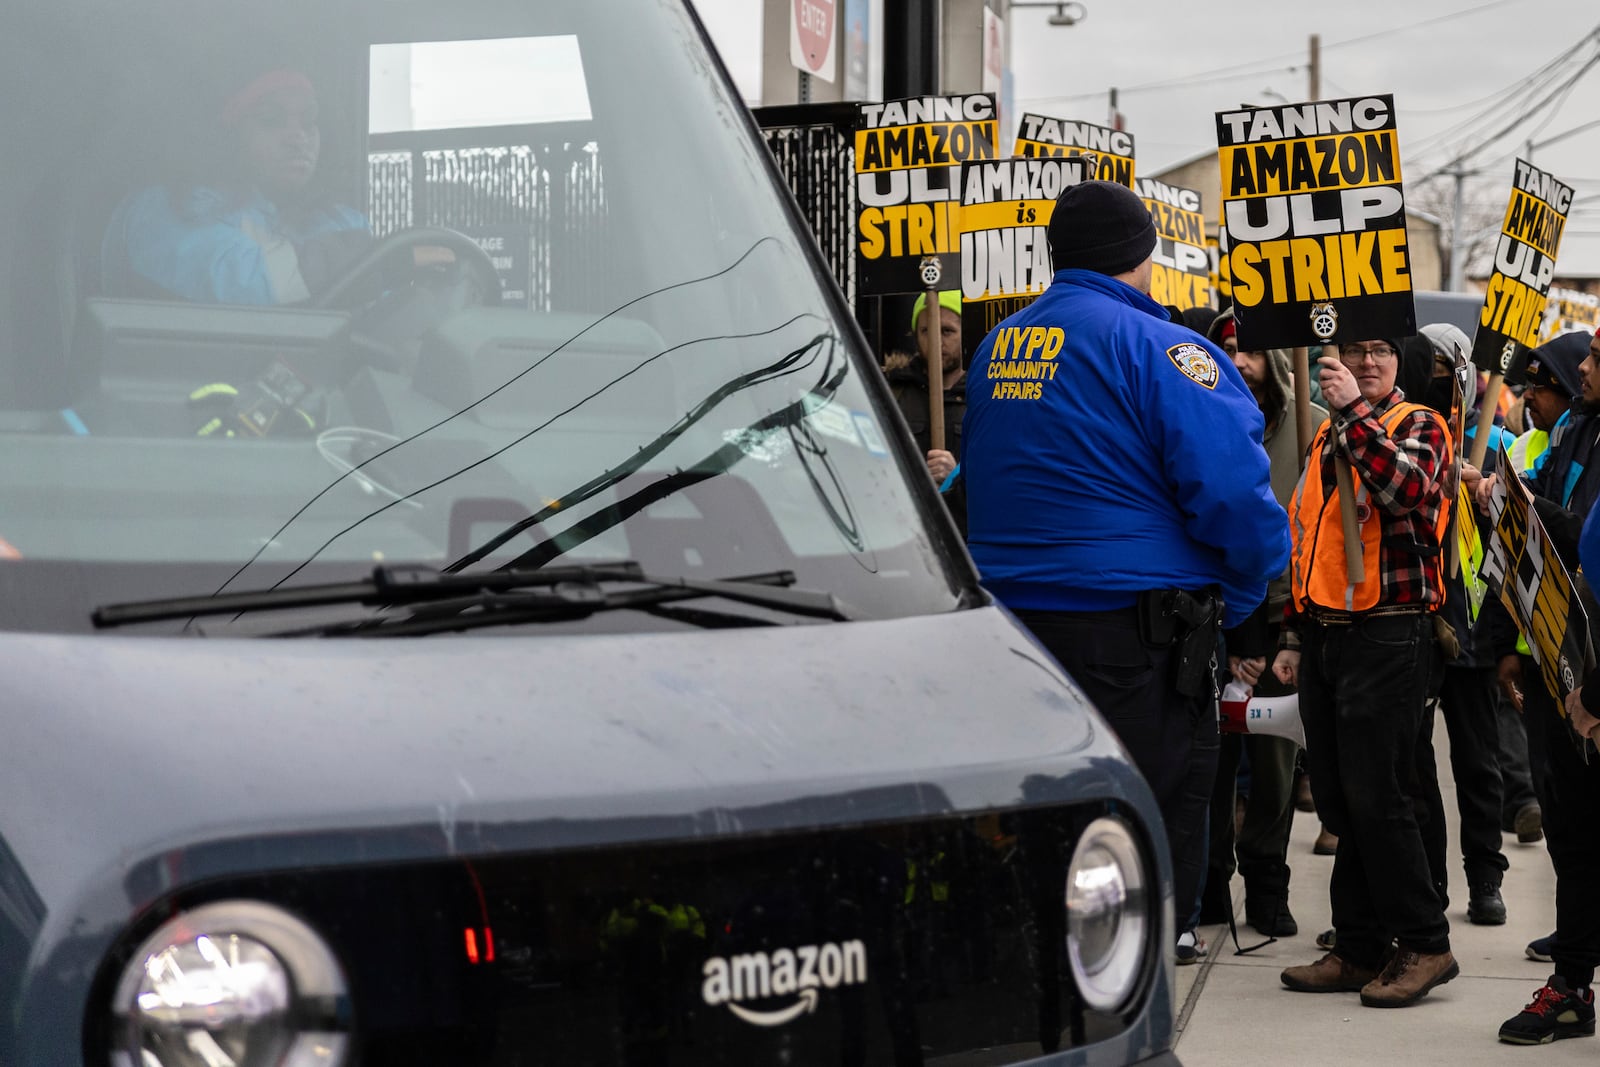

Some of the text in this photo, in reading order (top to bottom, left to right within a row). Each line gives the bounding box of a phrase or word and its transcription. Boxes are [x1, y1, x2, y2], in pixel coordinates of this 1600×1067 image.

[861, 94, 993, 129] TANNC
[1222, 97, 1388, 143] TANNC
[862, 122, 994, 170] AMAZON
[1024, 115, 1132, 156] TANNC
[963, 161, 1082, 206] AMAZON
[1230, 132, 1395, 196] AMAZON
[1016, 202, 1036, 224] is
[1135, 178, 1200, 212] NNC
[1225, 186, 1404, 242] ULP
[859, 201, 960, 260] STRI
[1150, 202, 1202, 245] AZON
[960, 226, 1052, 299] UNFA
[1151, 236, 1208, 273] LP
[1231, 228, 1411, 307] STRIKE
[1495, 235, 1555, 292] ULP
[1150, 264, 1210, 312] RIKE
[991, 326, 1065, 360] NYPD
[987, 361, 1059, 380] COMMUNITY
[991, 382, 1043, 400] AFFAIRS
[702, 938, 867, 1006] amazon
